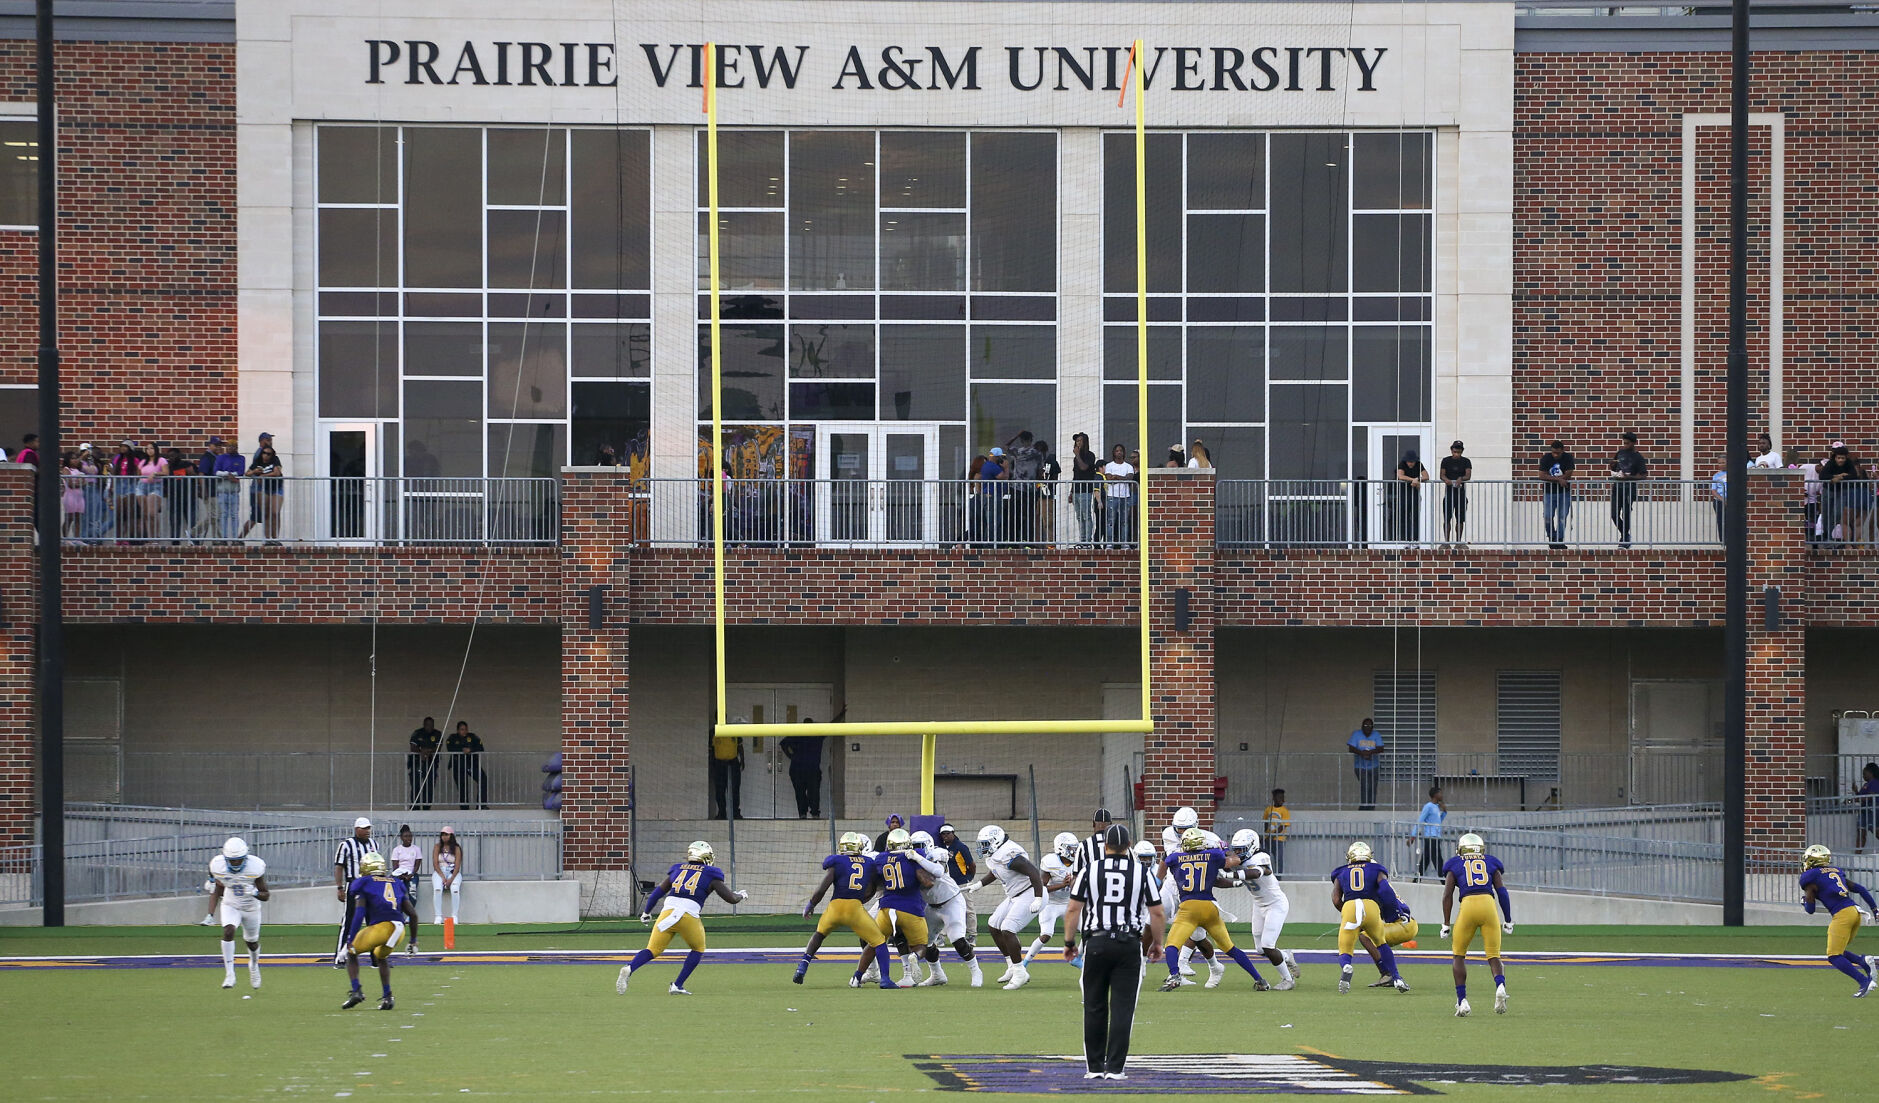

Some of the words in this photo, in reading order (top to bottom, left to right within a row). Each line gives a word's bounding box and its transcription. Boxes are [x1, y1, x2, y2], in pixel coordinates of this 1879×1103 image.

[364, 39, 619, 88] PRAIRIE
[639, 43, 811, 90] VIEW
[831, 45, 983, 91] A&M
[1004, 46, 1389, 92] UNIVERSITY
[671, 869, 702, 896] 44
[848, 862, 864, 891] 2
[882, 861, 905, 890] 91
[1103, 871, 1126, 903] B
[1180, 862, 1208, 892] 37
[1350, 867, 1365, 891] 0
[1463, 860, 1489, 887] 19
[1829, 873, 1848, 897] 3
[383, 882, 398, 910] 4
